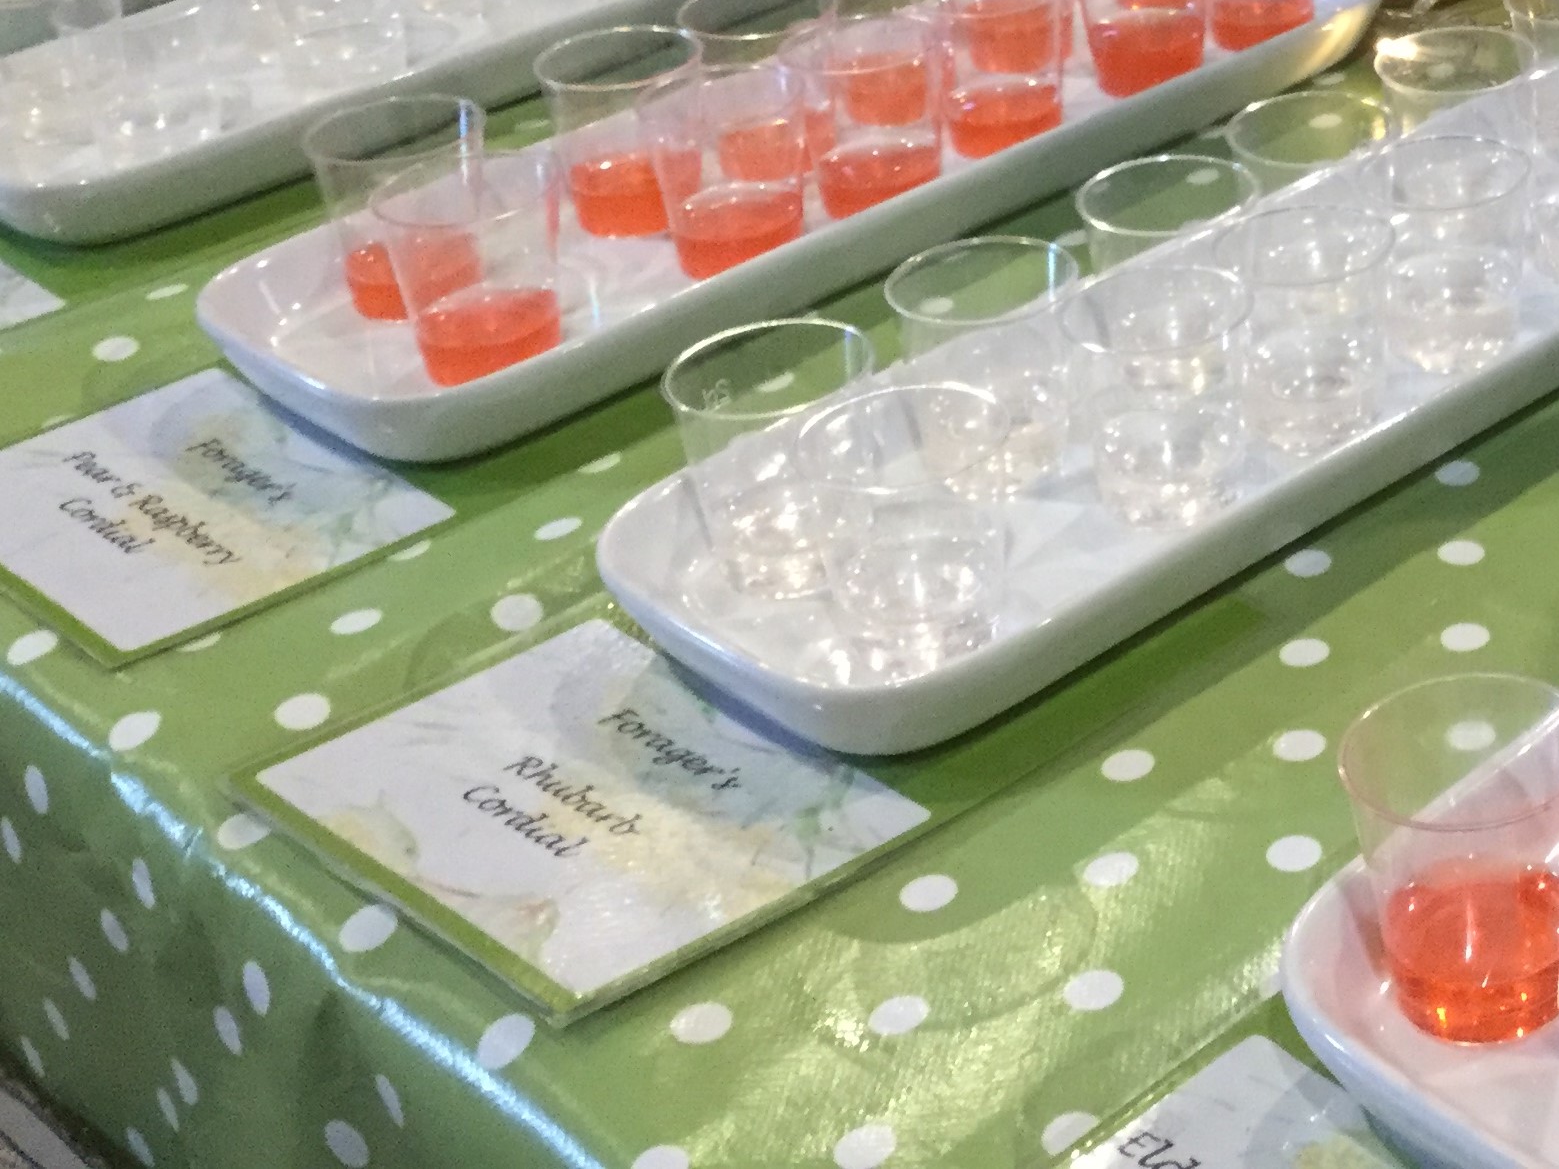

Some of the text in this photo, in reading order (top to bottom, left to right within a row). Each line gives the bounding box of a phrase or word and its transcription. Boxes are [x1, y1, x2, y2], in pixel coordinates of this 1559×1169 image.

[58, 497, 157, 555] Cordial
[597, 707, 742, 791] Forager's
[462, 783, 591, 858] Cordial
[503, 754, 643, 836] Rhubarb
